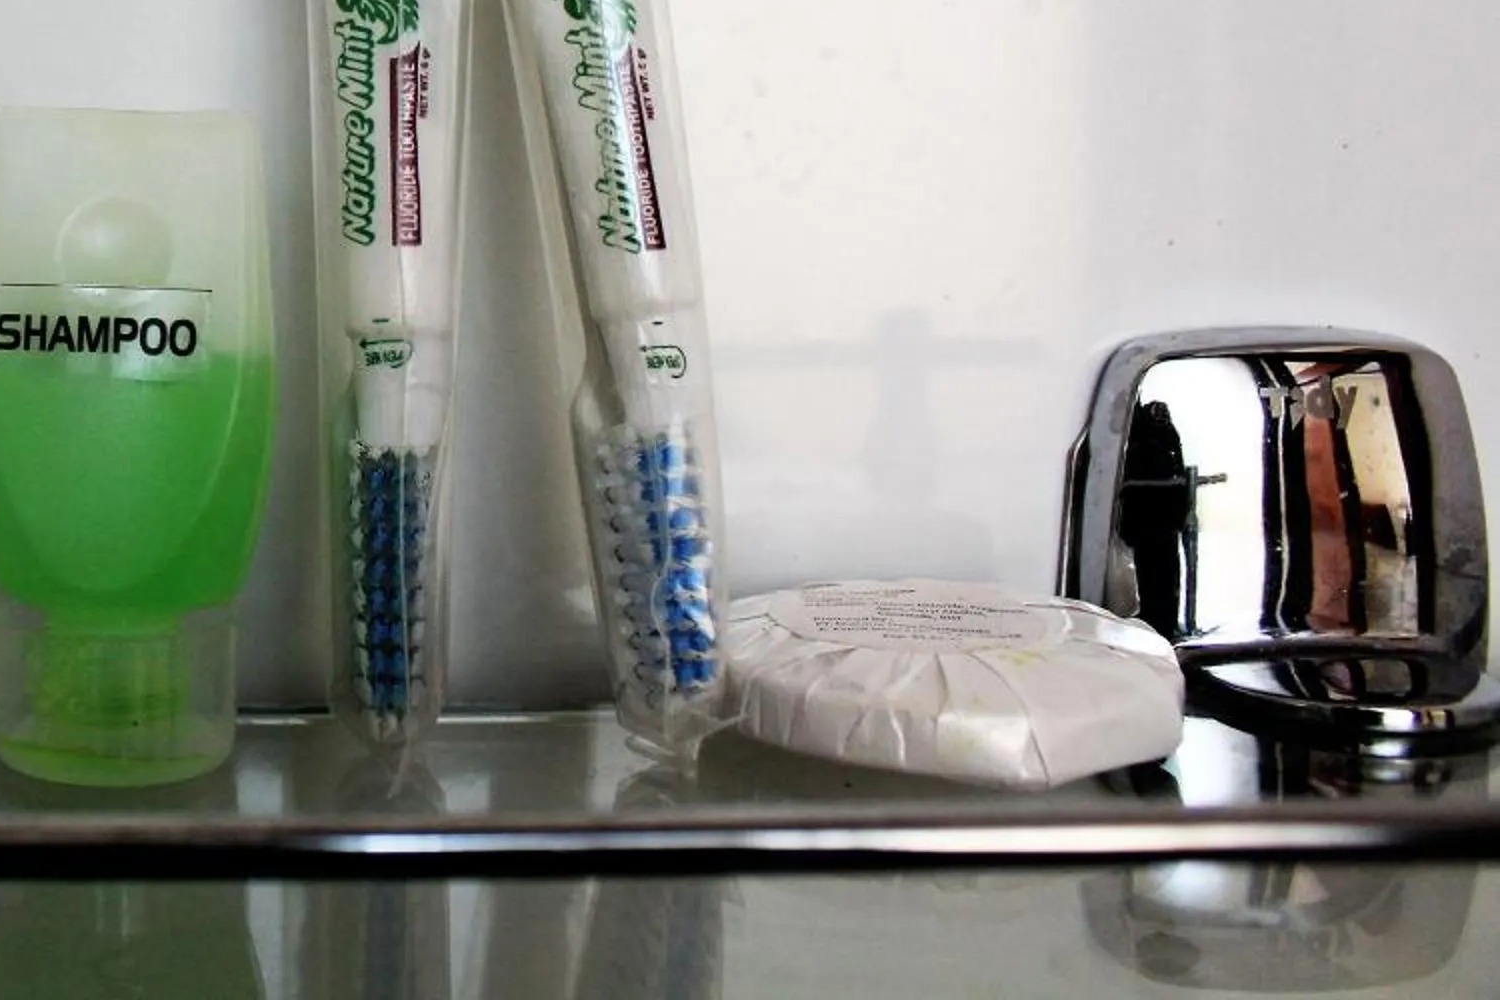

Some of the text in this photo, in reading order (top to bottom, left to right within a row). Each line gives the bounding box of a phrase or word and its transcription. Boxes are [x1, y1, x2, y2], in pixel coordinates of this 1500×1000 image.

[334, 19, 376, 247] Nature Mint
[399, 61, 419, 242] FLUORIDE TOOTHPASTE
[595, 117, 642, 255] Nature
[617, 63, 659, 247] FLUORIDE TOOTHPASTE
